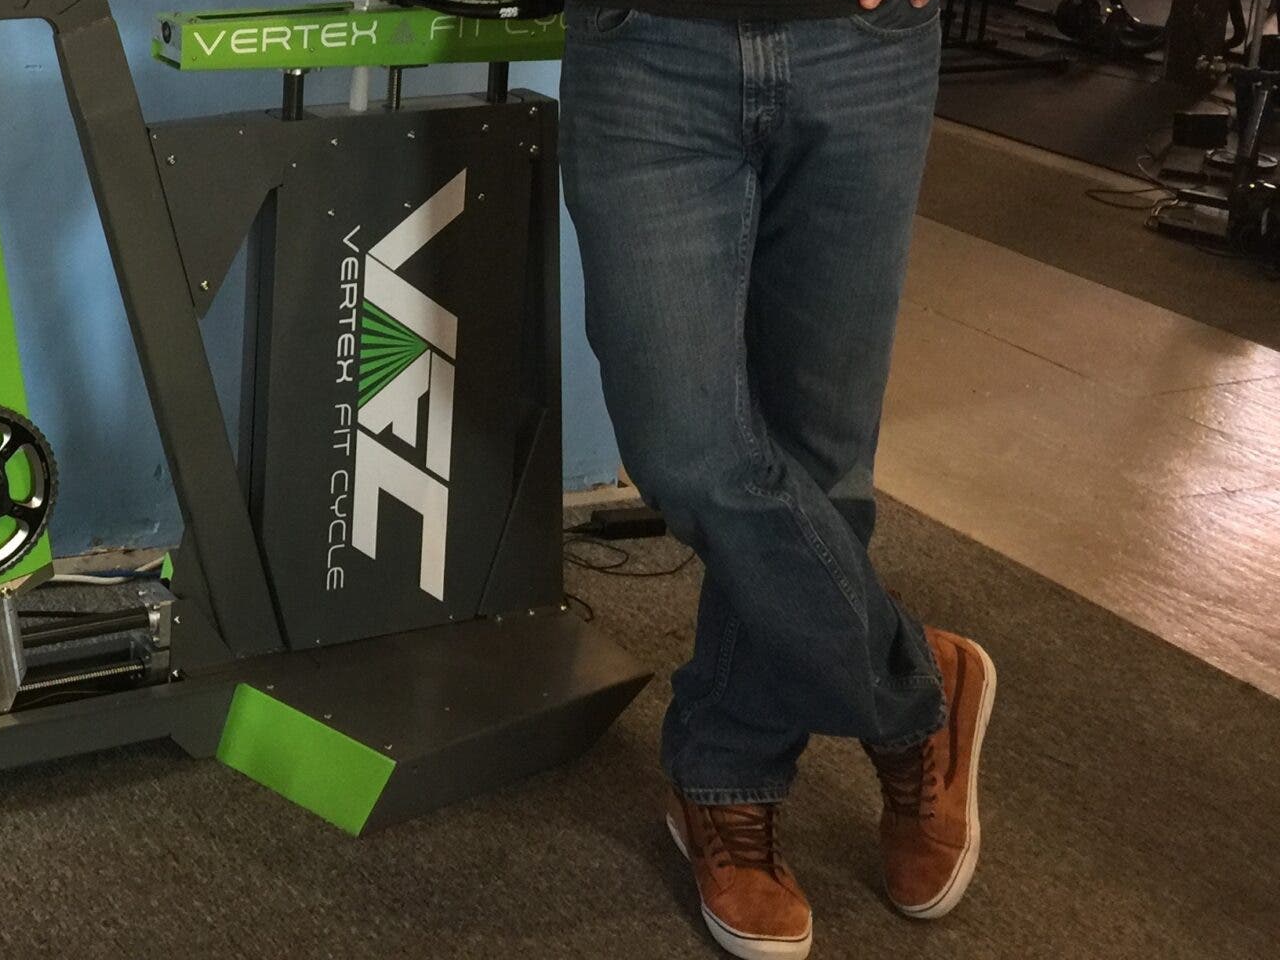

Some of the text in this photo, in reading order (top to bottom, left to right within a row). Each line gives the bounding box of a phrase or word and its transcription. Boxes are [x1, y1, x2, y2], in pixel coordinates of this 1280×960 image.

[192, 18, 379, 57] VERTEX
[325, 224, 362, 593] VERTEX FIT CYCLE
